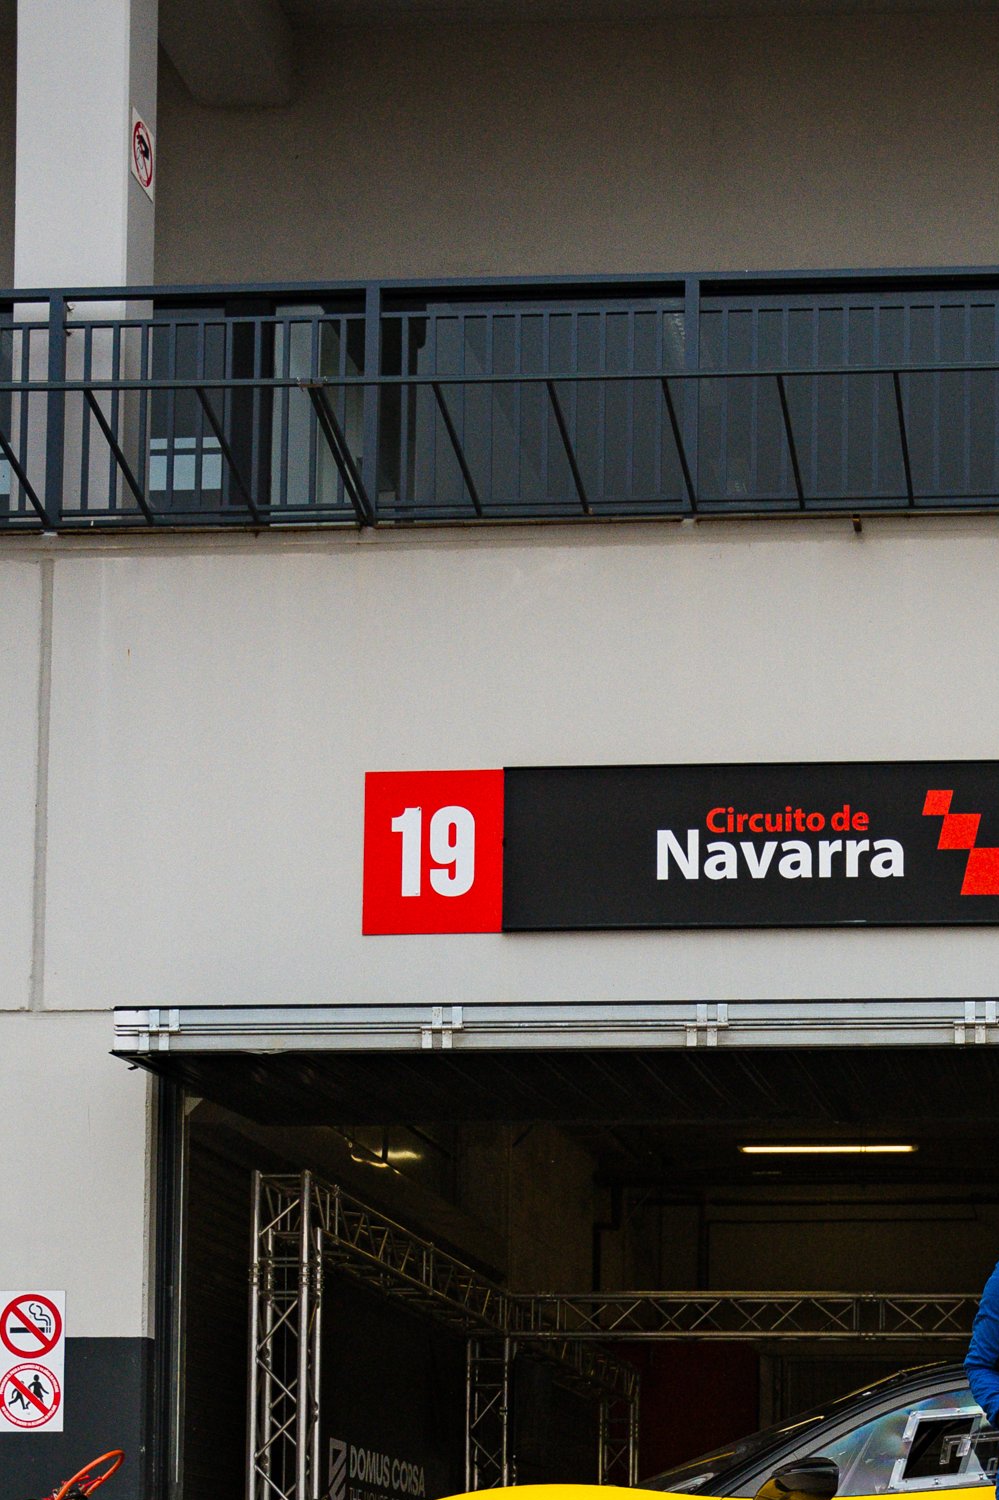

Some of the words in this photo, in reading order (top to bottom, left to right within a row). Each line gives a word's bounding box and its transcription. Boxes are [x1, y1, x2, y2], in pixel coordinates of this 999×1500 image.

[706, 804, 825, 833] Circuito
[831, 804, 870, 832] de
[391, 806, 475, 897] 19
[656, 828, 905, 881] Navarra
[349, 1444, 391, 1489] DOMUS
[391, 1457, 426, 1498] CORSA
